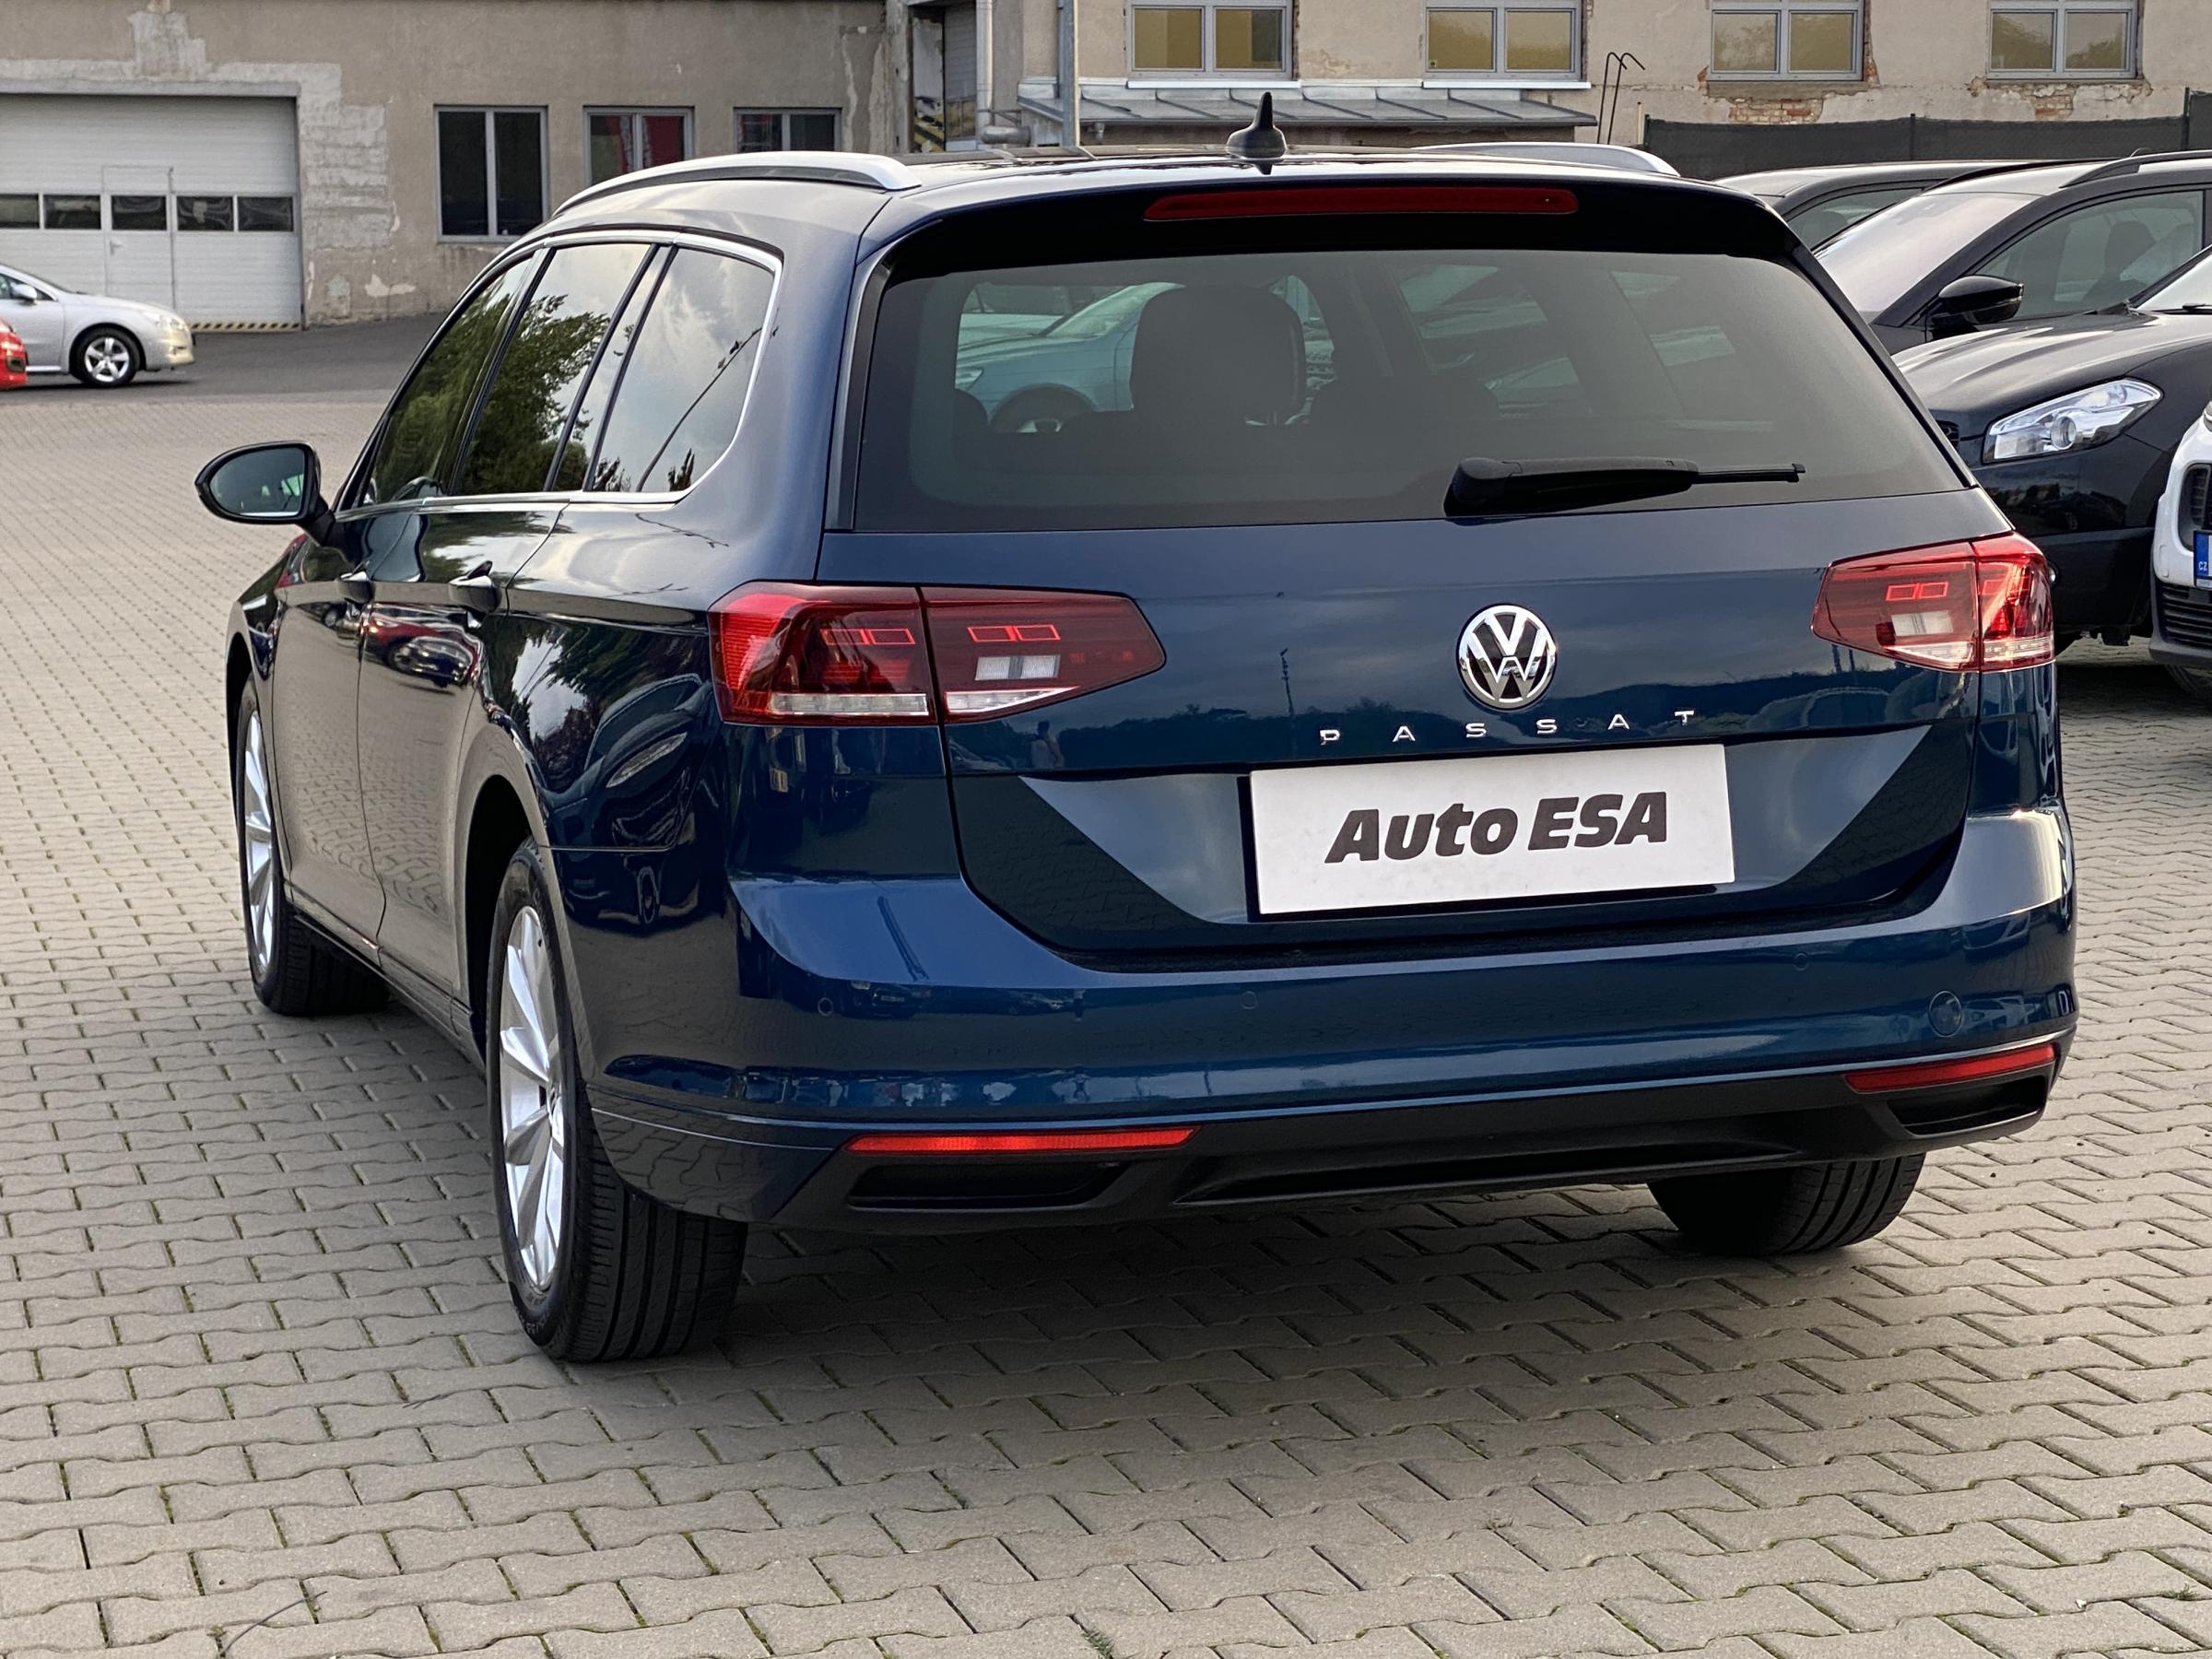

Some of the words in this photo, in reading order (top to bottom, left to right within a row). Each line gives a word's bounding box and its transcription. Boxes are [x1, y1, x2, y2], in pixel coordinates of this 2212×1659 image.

[2198, 561, 2208, 571] CZ
[1319, 710, 1696, 746] PASSAT
[1324, 803, 1519, 864] Auto
[1527, 791, 1667, 851] ESA
